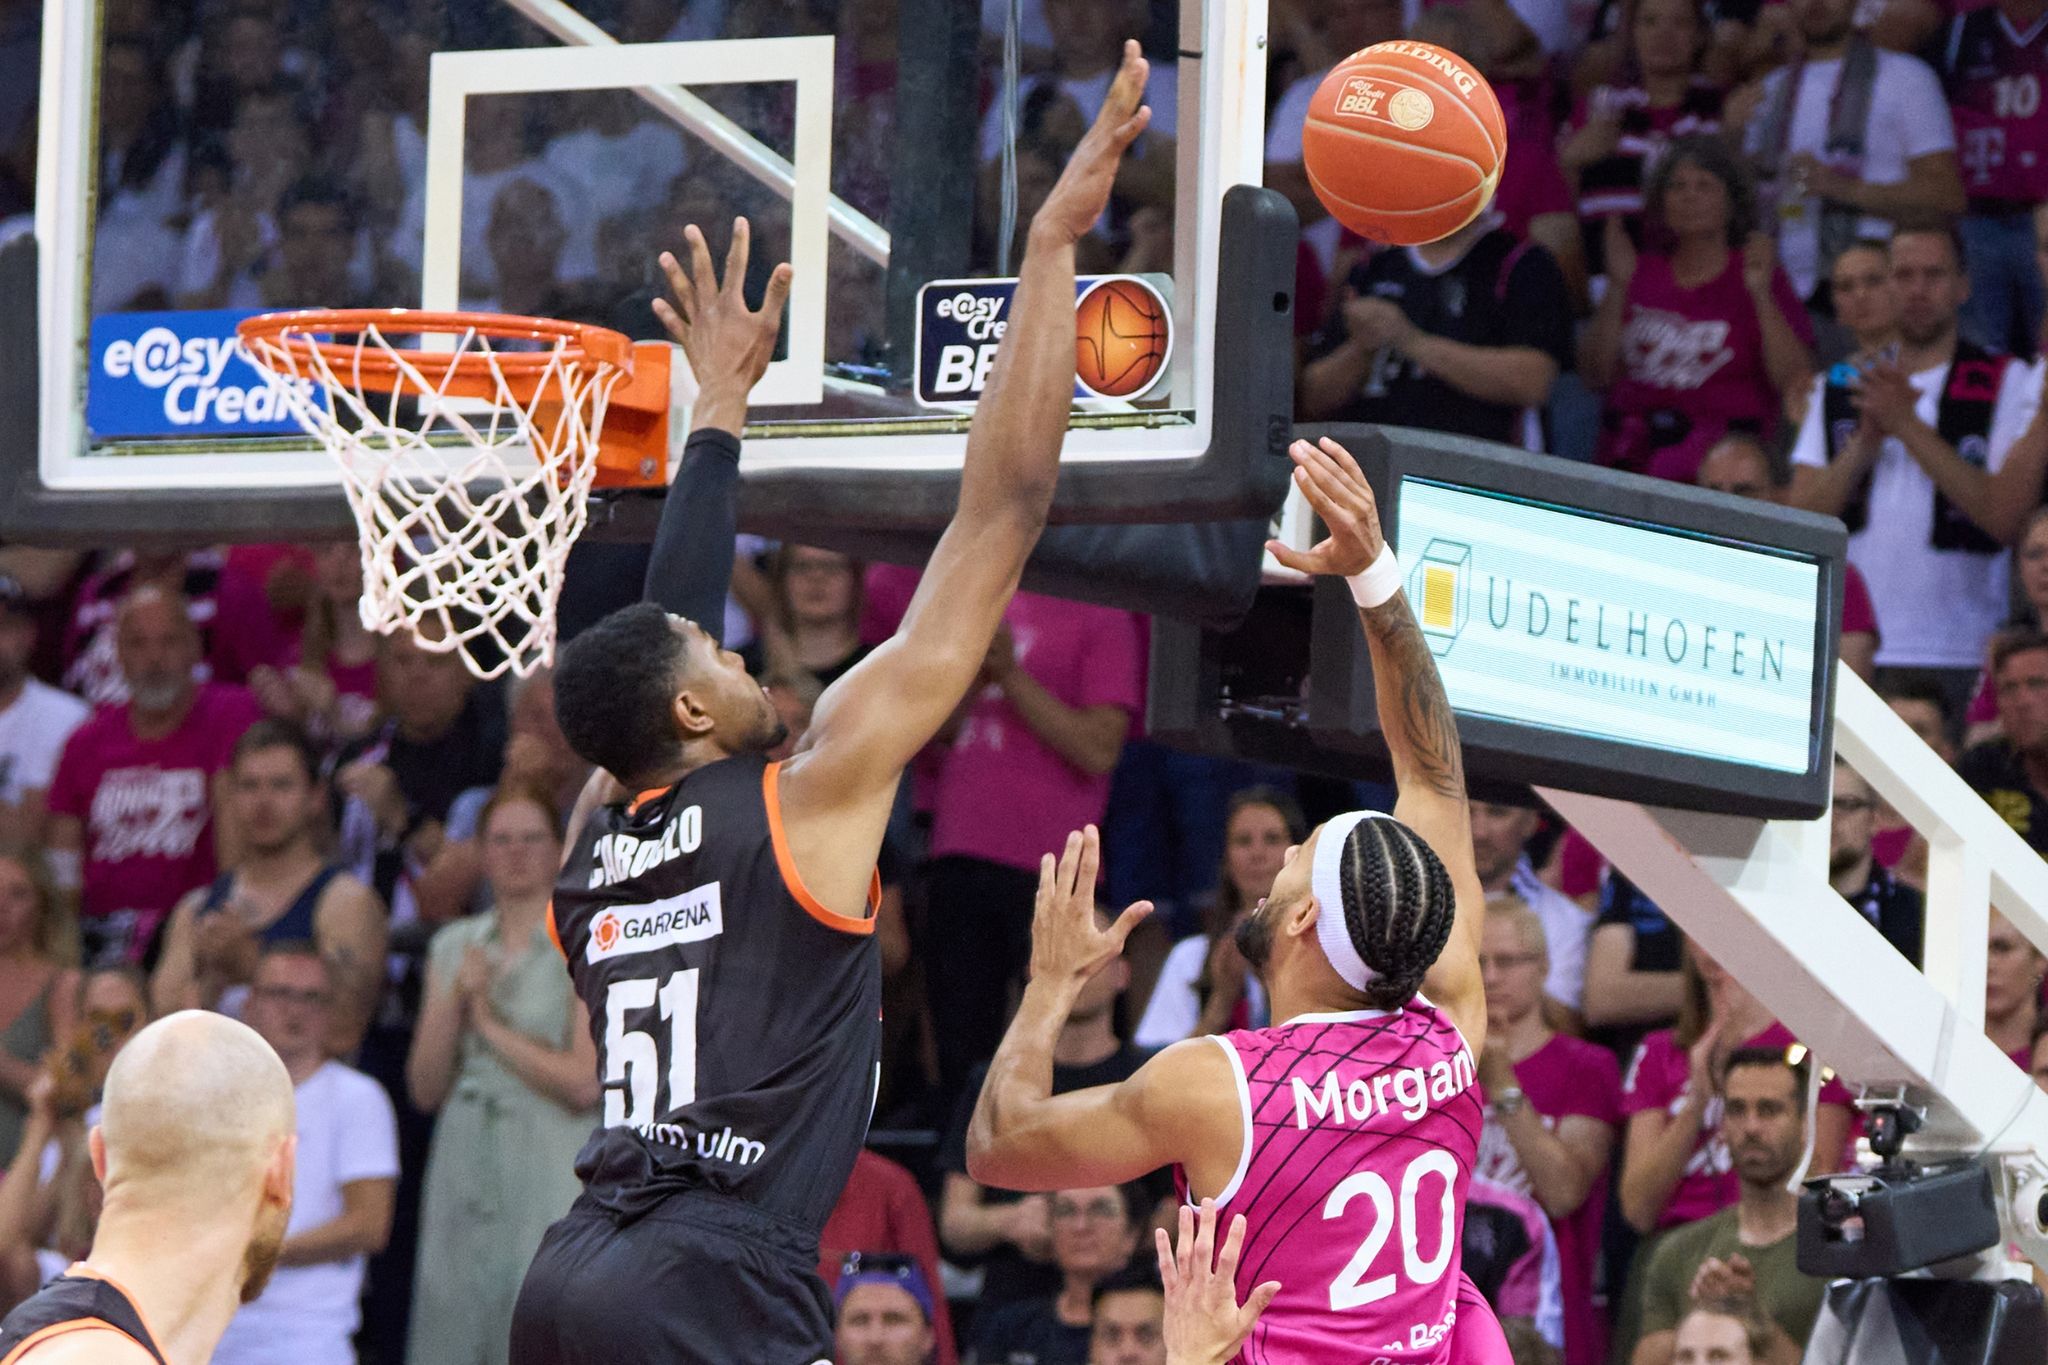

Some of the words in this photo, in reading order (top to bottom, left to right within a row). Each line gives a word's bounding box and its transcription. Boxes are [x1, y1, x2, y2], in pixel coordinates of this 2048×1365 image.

[1341, 95, 1378, 115] BBL
[1994, 74, 2041, 118] 10
[937, 293, 1005, 322] e@sy
[967, 314, 1009, 340] Cre
[103, 327, 240, 388] e@sy
[1488, 576, 1784, 682] UDELHOFEN
[1550, 661, 1659, 696] IMMOBILIEN
[604, 967, 700, 1130] 51
[1291, 1049, 1474, 1131] Morgan
[697, 1126, 766, 1166] ulm
[1322, 1149, 1459, 1312] 20
